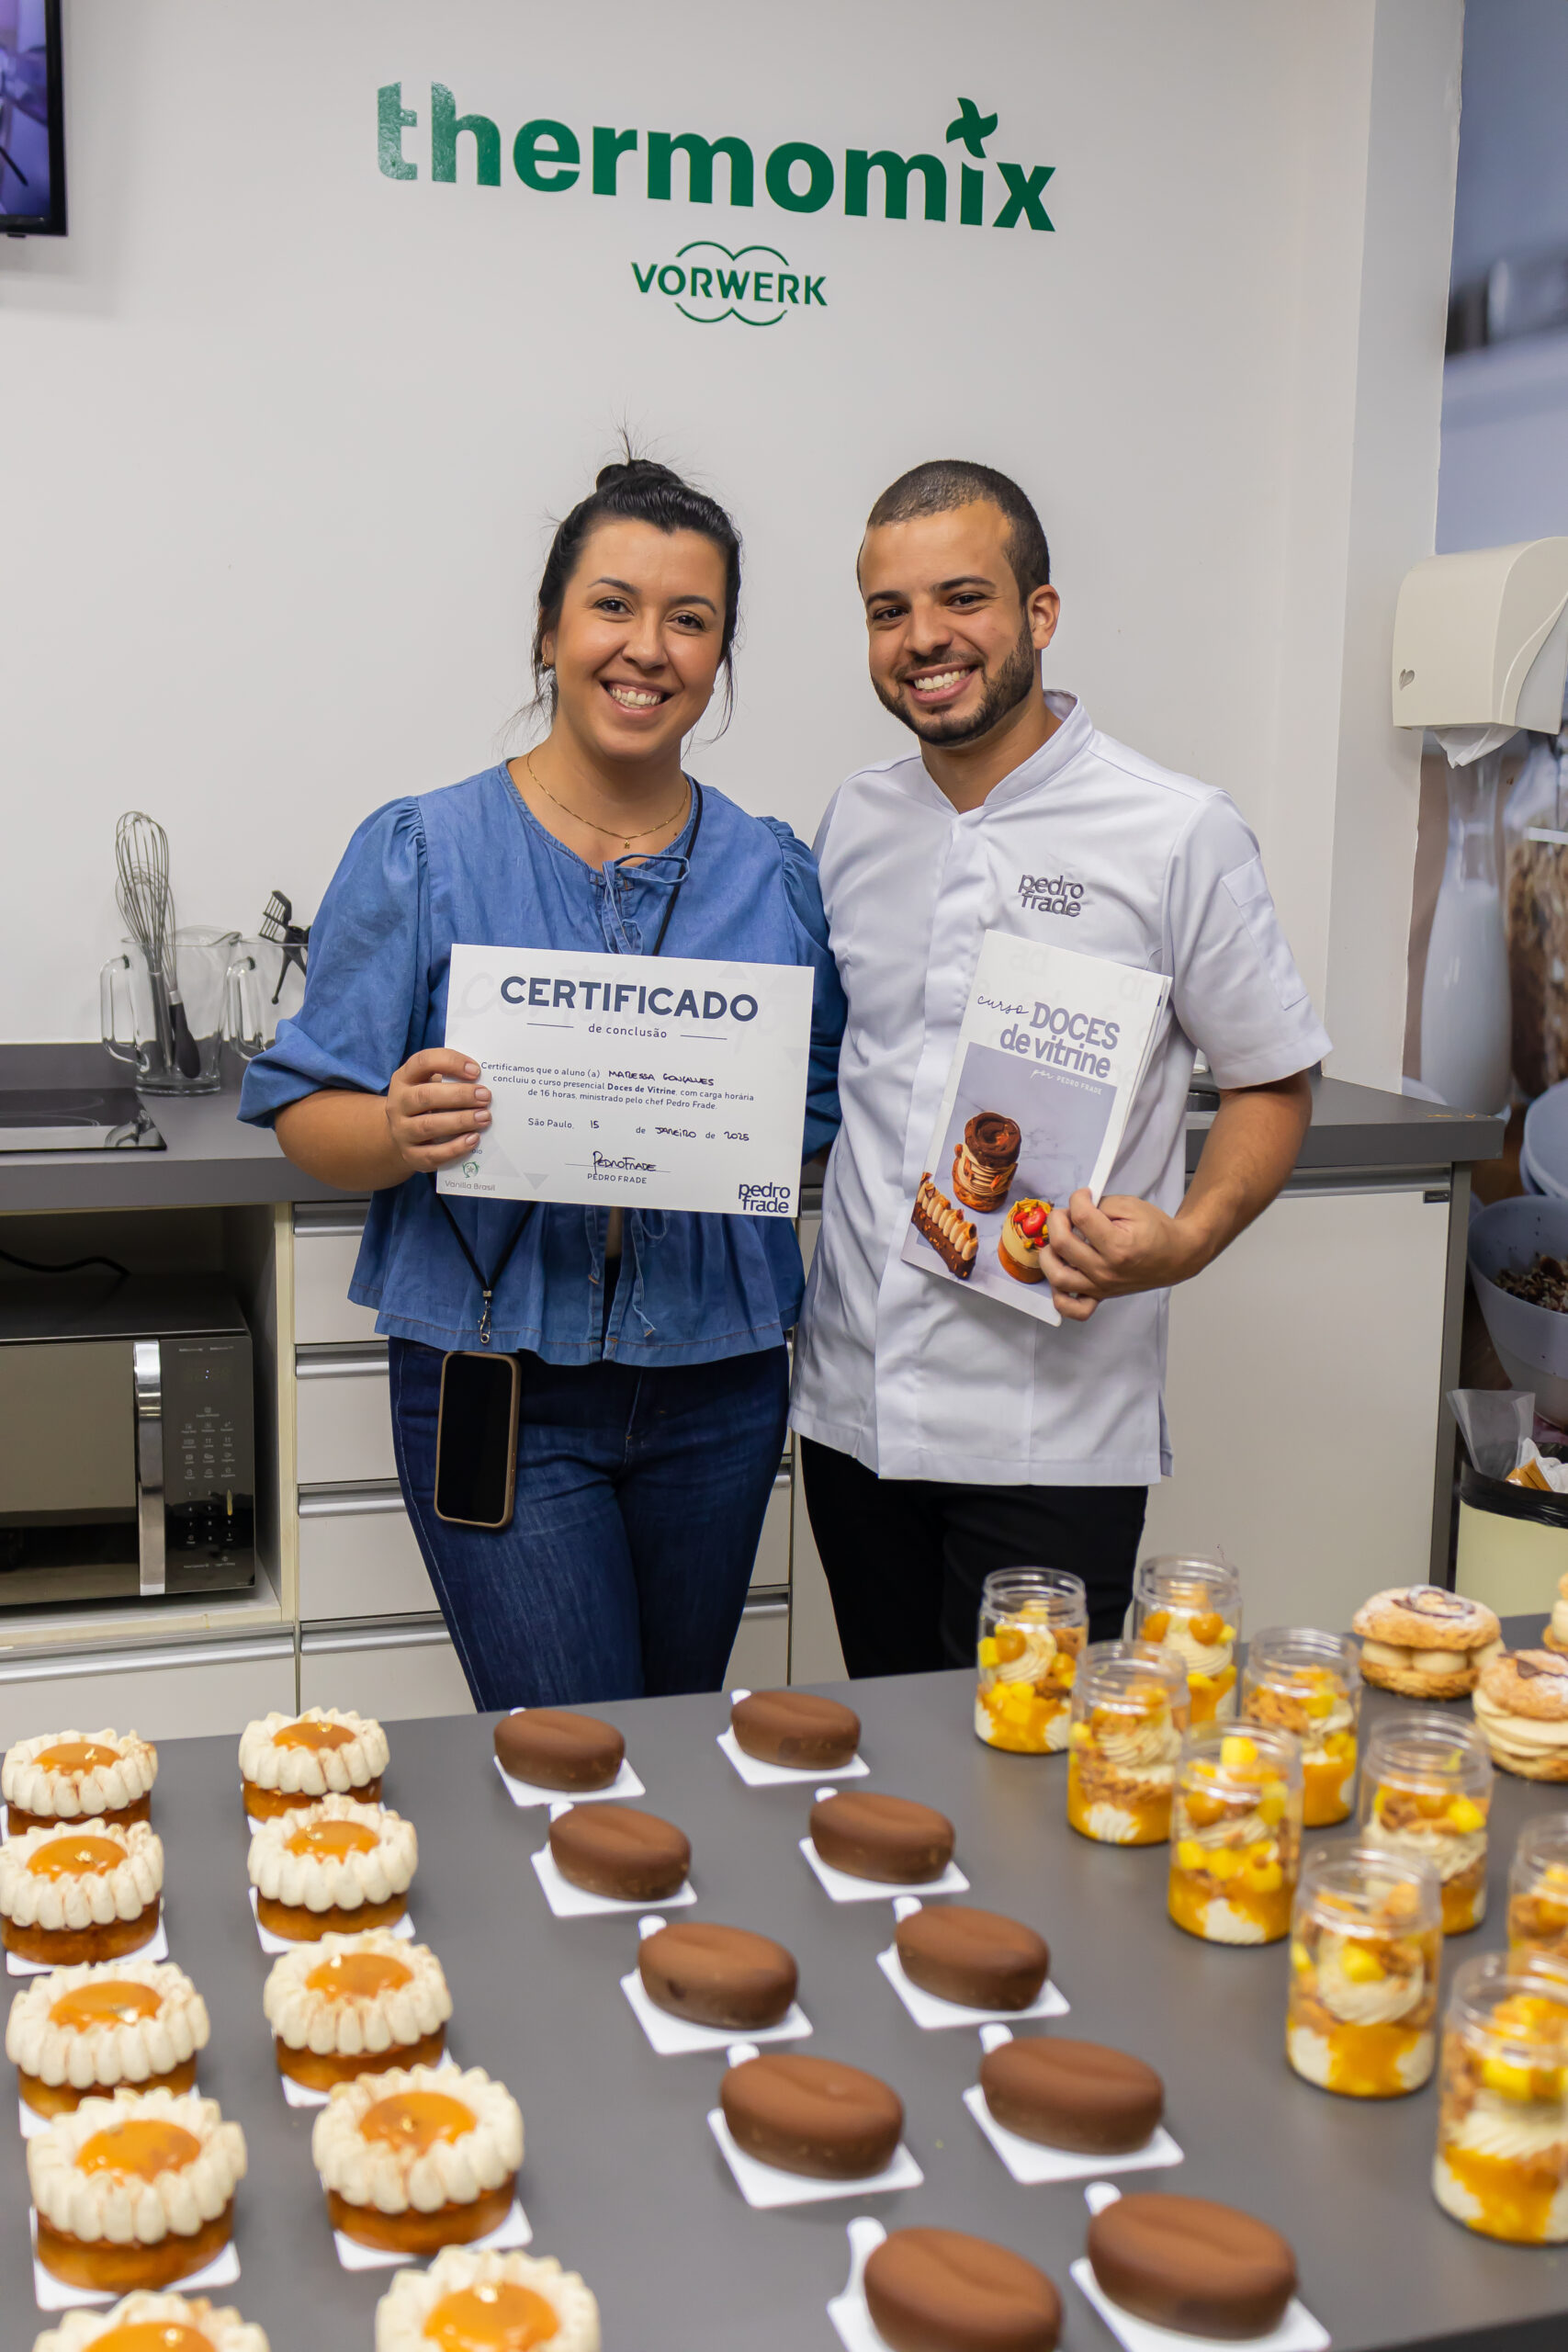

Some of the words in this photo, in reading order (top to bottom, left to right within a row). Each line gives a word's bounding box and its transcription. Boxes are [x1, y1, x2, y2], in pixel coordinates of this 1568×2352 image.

[377, 81, 1056, 232] thermomix
[630, 262, 828, 307] VORWERK
[1018, 875, 1084, 899] pedro
[1021, 889, 1081, 917] frade
[500, 976, 759, 1022] CERTIFICADO
[588, 1023, 603, 1034] de
[606, 1025, 668, 1038] conclusão
[977, 995, 1029, 1014] curso
[1029, 1001, 1121, 1050] DOCES
[1000, 1023, 1031, 1054] de
[1035, 1035, 1111, 1079] vitrine
[480, 1062, 535, 1073] Certificamos
[536, 1067, 552, 1077] que
[561, 1069, 585, 1077] aluno
[587, 1069, 601, 1079] (a)
[492, 1075, 529, 1084] concluiu
[538, 1078, 561, 1087] curso
[563, 1080, 605, 1090] presencial
[607, 1083, 633, 1091] Doces
[635, 1084, 645, 1092] de
[680, 1089, 698, 1097] com
[699, 1091, 723, 1100] carga
[724, 1091, 754, 1102] horária
[527, 1088, 538, 1096] de
[580, 1092, 624, 1102] ministrado
[626, 1096, 643, 1104] pelo
[666, 1099, 690, 1107] Pedro
[528, 1117, 545, 1126] São
[590, 1120, 600, 1129] 15
[636, 1126, 646, 1135] de
[705, 1131, 716, 1139] de
[723, 1131, 750, 1141] 2025
[445, 1180, 472, 1190] Vanilla
[473, 1182, 496, 1192] Brasil
[587, 1173, 616, 1182] PEDRO
[618, 1175, 648, 1183] FRADE
[738, 1182, 791, 1199] pedro
[741, 1195, 789, 1214] frade
